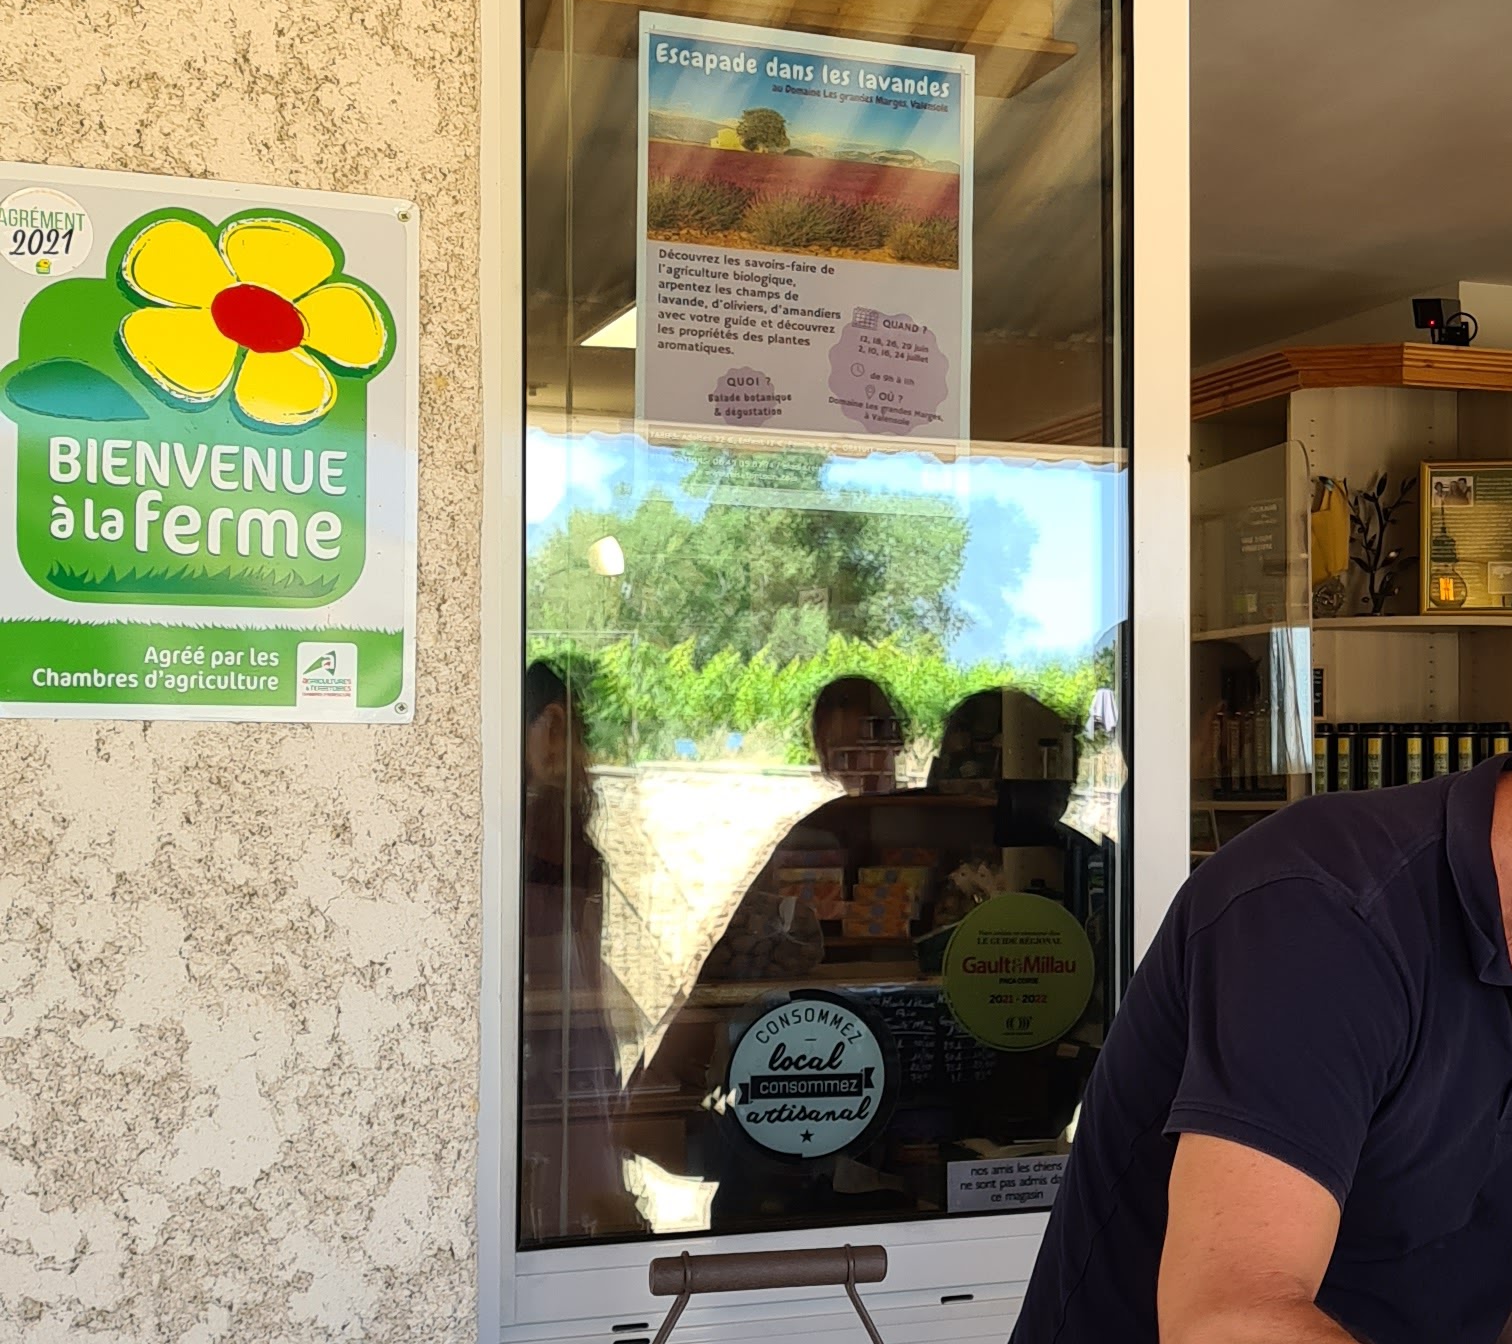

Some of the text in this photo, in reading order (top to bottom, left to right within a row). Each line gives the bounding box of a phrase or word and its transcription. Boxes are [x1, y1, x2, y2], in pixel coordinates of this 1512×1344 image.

[655, 42, 950, 98] Escapade dans les lavandes
[0, 206, 85, 231] AGRÉMENT
[9, 229, 74, 255] 2021
[659, 249, 835, 275] Découvrez les savoirs-faire de
[658, 264, 796, 287] l'agriculture biologique,
[658, 279, 799, 301] arpentez les champs de
[658, 294, 841, 320] lavande, d'oliviers, d'amandiers
[657, 311, 836, 334] avec votre guide et découvrez
[882, 319, 919, 333] QUAND
[657, 324, 810, 346] les propriétés des plantes
[657, 340, 735, 355] aromatiques.
[727, 377, 759, 387] QUOI
[708, 393, 792, 404] Balade botanique
[879, 391, 894, 402] OÙ
[49, 436, 348, 495] BIENVENUE
[50, 489, 342, 560] à la ferme
[144, 646, 279, 669] Agréé par les
[32, 667, 279, 692] Chambres d'agriculture
[989, 994, 1014, 1004] 2021
[1022, 994, 1048, 1004] 2022
[755, 1007, 862, 1045] CONSOMMEZ
[768, 1041, 845, 1072] local
[760, 1079, 858, 1094] consommez
[746, 1095, 871, 1124] artisanal
[970, 1162, 1062, 1176] nos amis les chiens
[960, 1182, 973, 1190] ne
[976, 1179, 996, 1189] sont
[1000, 1178, 1016, 1191] pas
[1019, 1175, 1047, 1186] admis
[991, 1189, 1043, 1203] ce magasin
